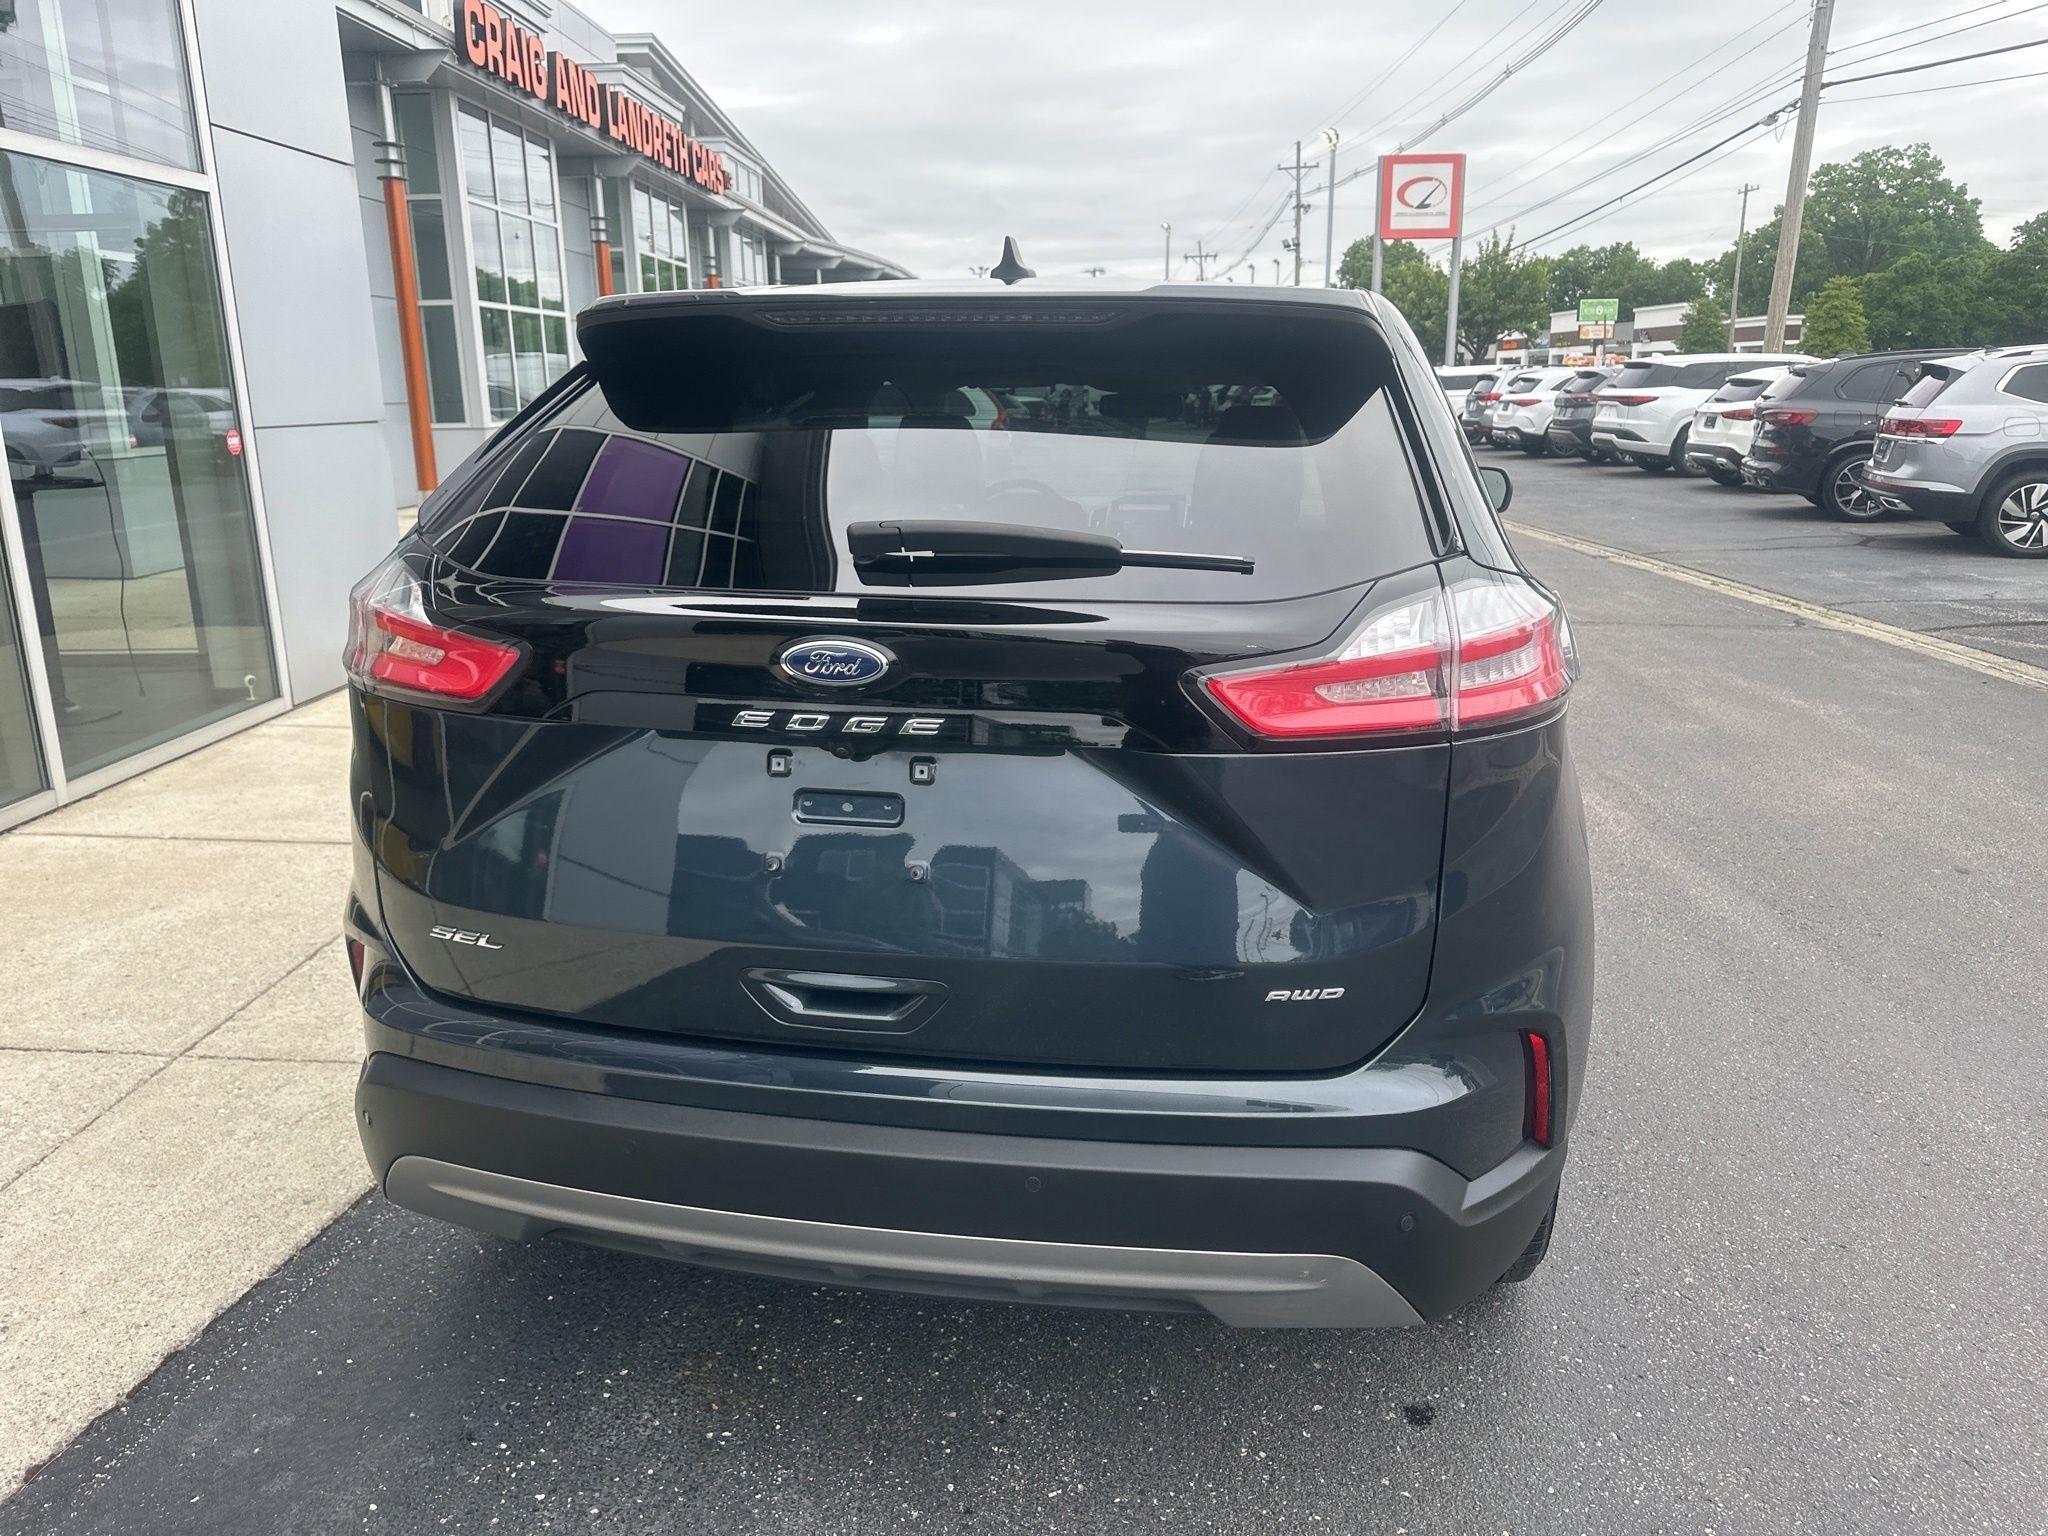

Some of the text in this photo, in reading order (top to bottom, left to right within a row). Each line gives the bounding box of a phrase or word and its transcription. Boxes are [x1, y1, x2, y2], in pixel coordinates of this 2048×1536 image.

[464, 0, 725, 195] CRAIG AND LANDRETH CARS
[804, 650, 861, 676] Ford
[731, 710, 946, 735] EDGE
[429, 925, 503, 949] SEL
[1264, 987, 1346, 1001] AWD
